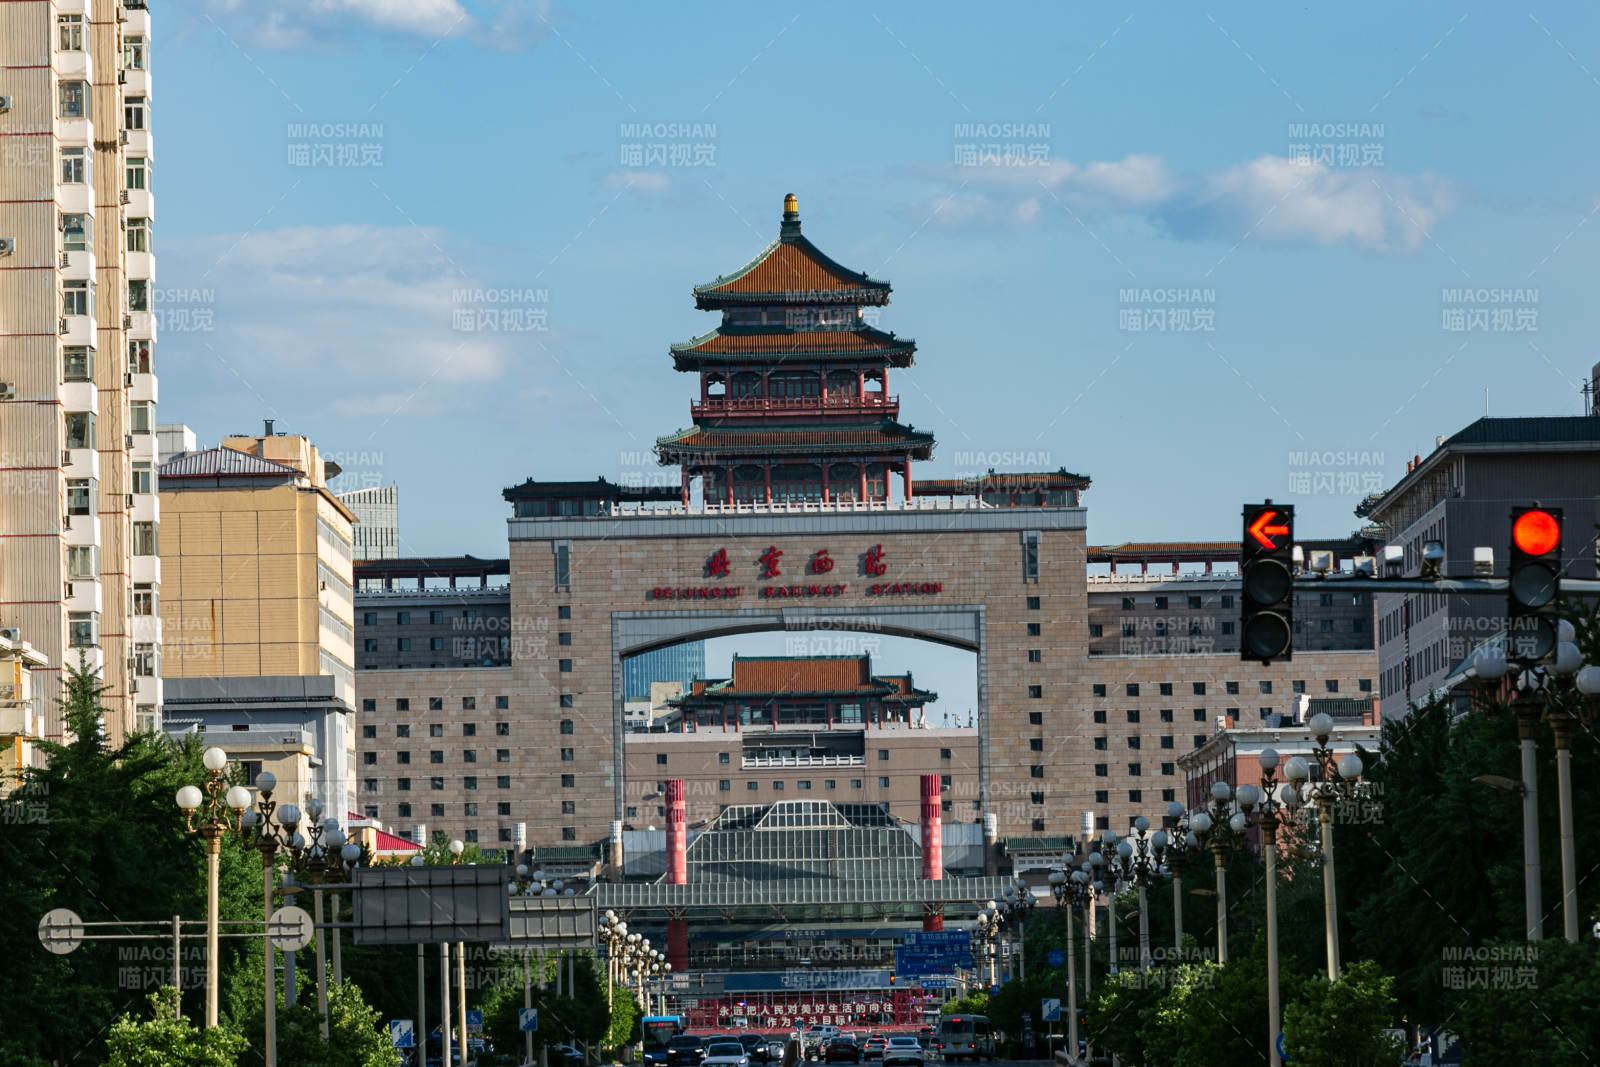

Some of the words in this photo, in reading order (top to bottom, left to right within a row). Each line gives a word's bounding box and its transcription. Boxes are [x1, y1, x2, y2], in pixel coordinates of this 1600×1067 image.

[708, 544, 887, 577] 北京西站
[653, 586, 742, 599] BEIJINGXI
[765, 584, 847, 598] RAILWAY
[871, 582, 943, 595] STATION
[719, 1003, 894, 1017] 永远把人民对美好生活的向往
